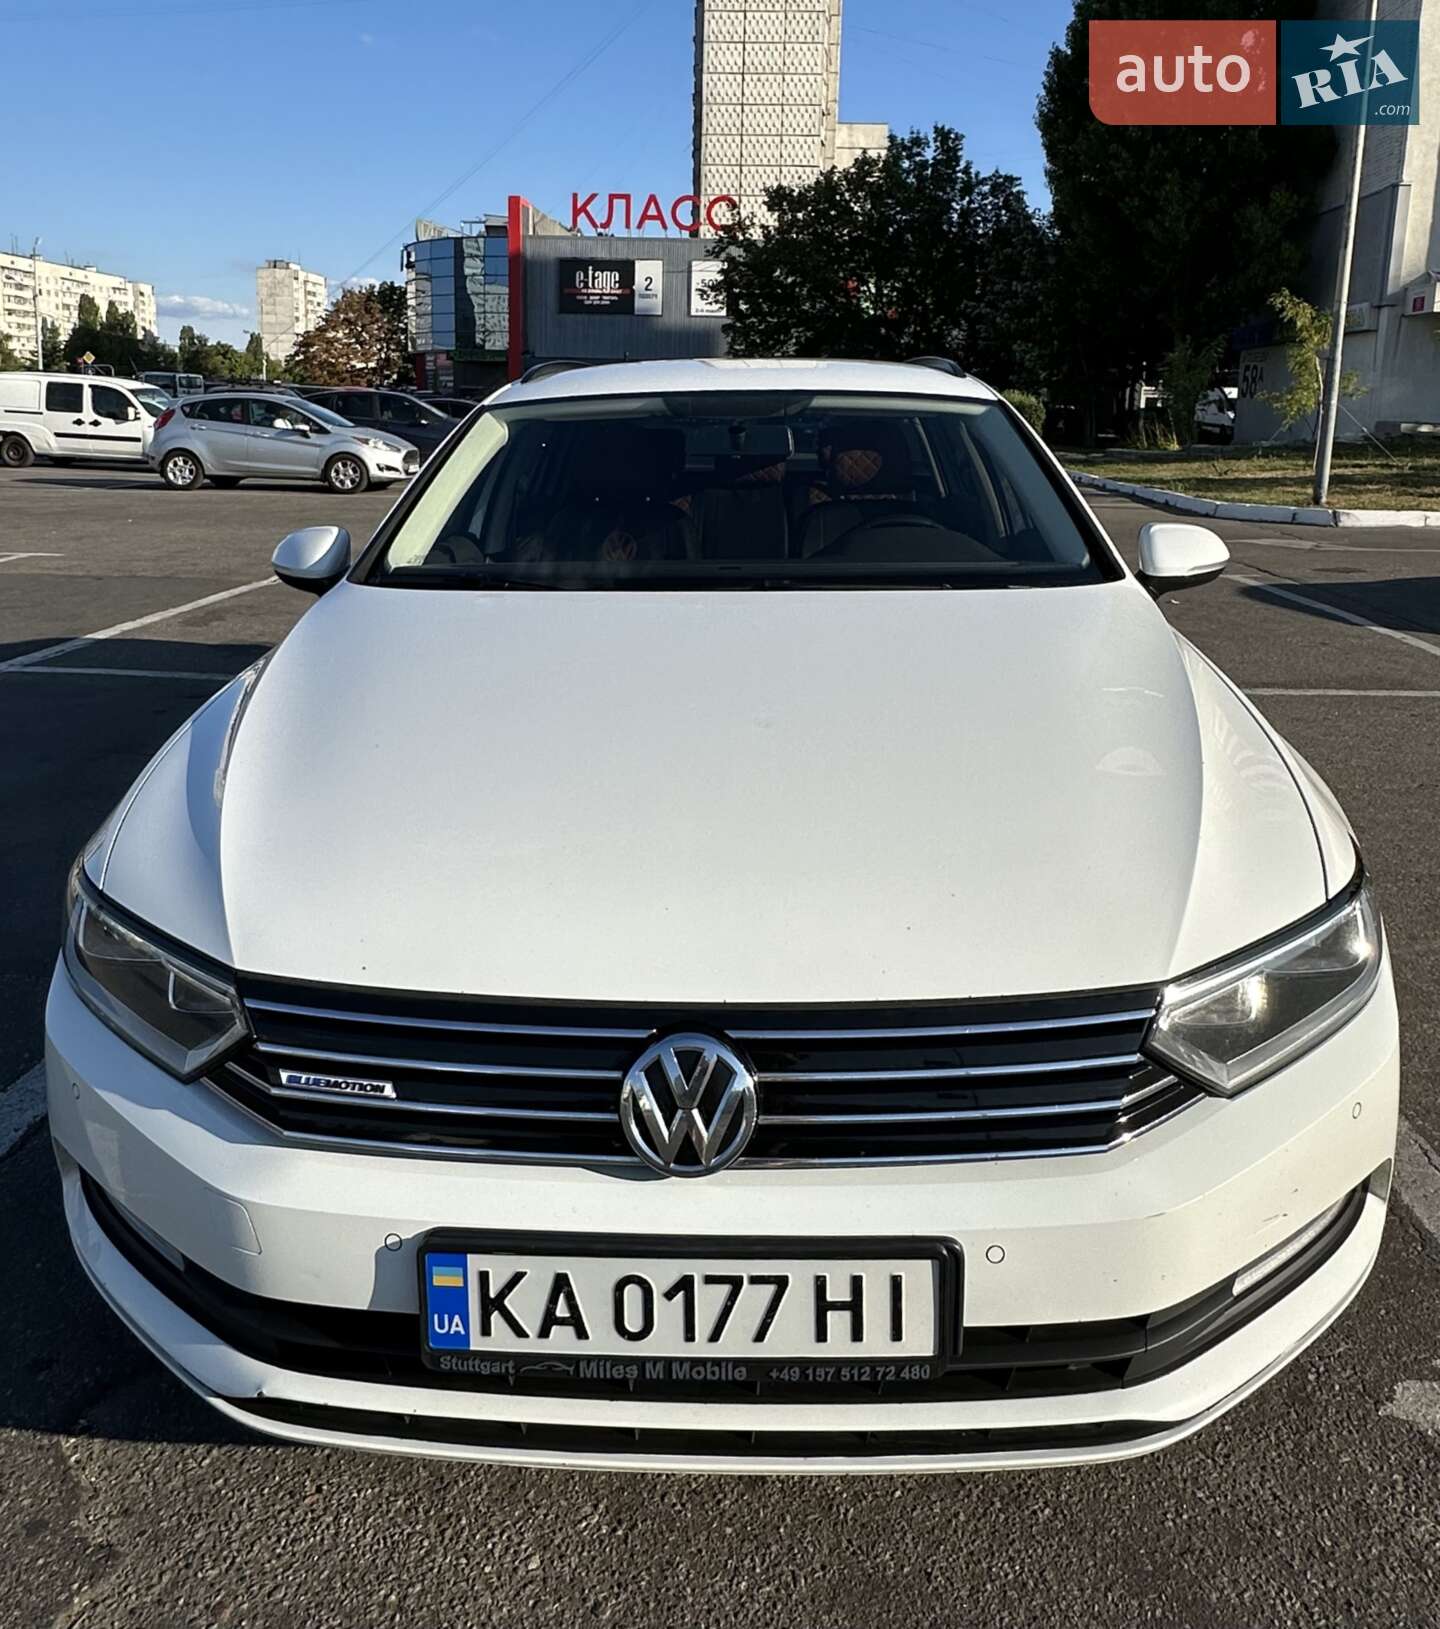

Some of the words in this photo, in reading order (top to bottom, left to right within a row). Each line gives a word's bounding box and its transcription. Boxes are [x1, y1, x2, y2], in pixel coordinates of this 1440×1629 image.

[572, 192, 738, 232] КЛАСС
[575, 265, 619, 293] e-tage
[644, 276, 653, 291] 2
[285, 1073, 386, 1095] BLUEMOTION
[477, 1269, 590, 1341] KA
[613, 1272, 790, 1343] 0177
[815, 1273, 904, 1343] HI
[433, 1313, 465, 1336] UA
[439, 1355, 515, 1375] Stuttgart
[579, 1360, 639, 1379] Miles
[645, 1361, 664, 1379] M
[671, 1361, 747, 1381] Mobile
[769, 1367, 800, 1381] +49
[806, 1366, 833, 1381] 157
[840, 1366, 871, 1381] 512
[877, 1365, 896, 1381] 72
[901, 1364, 930, 1380] 480
